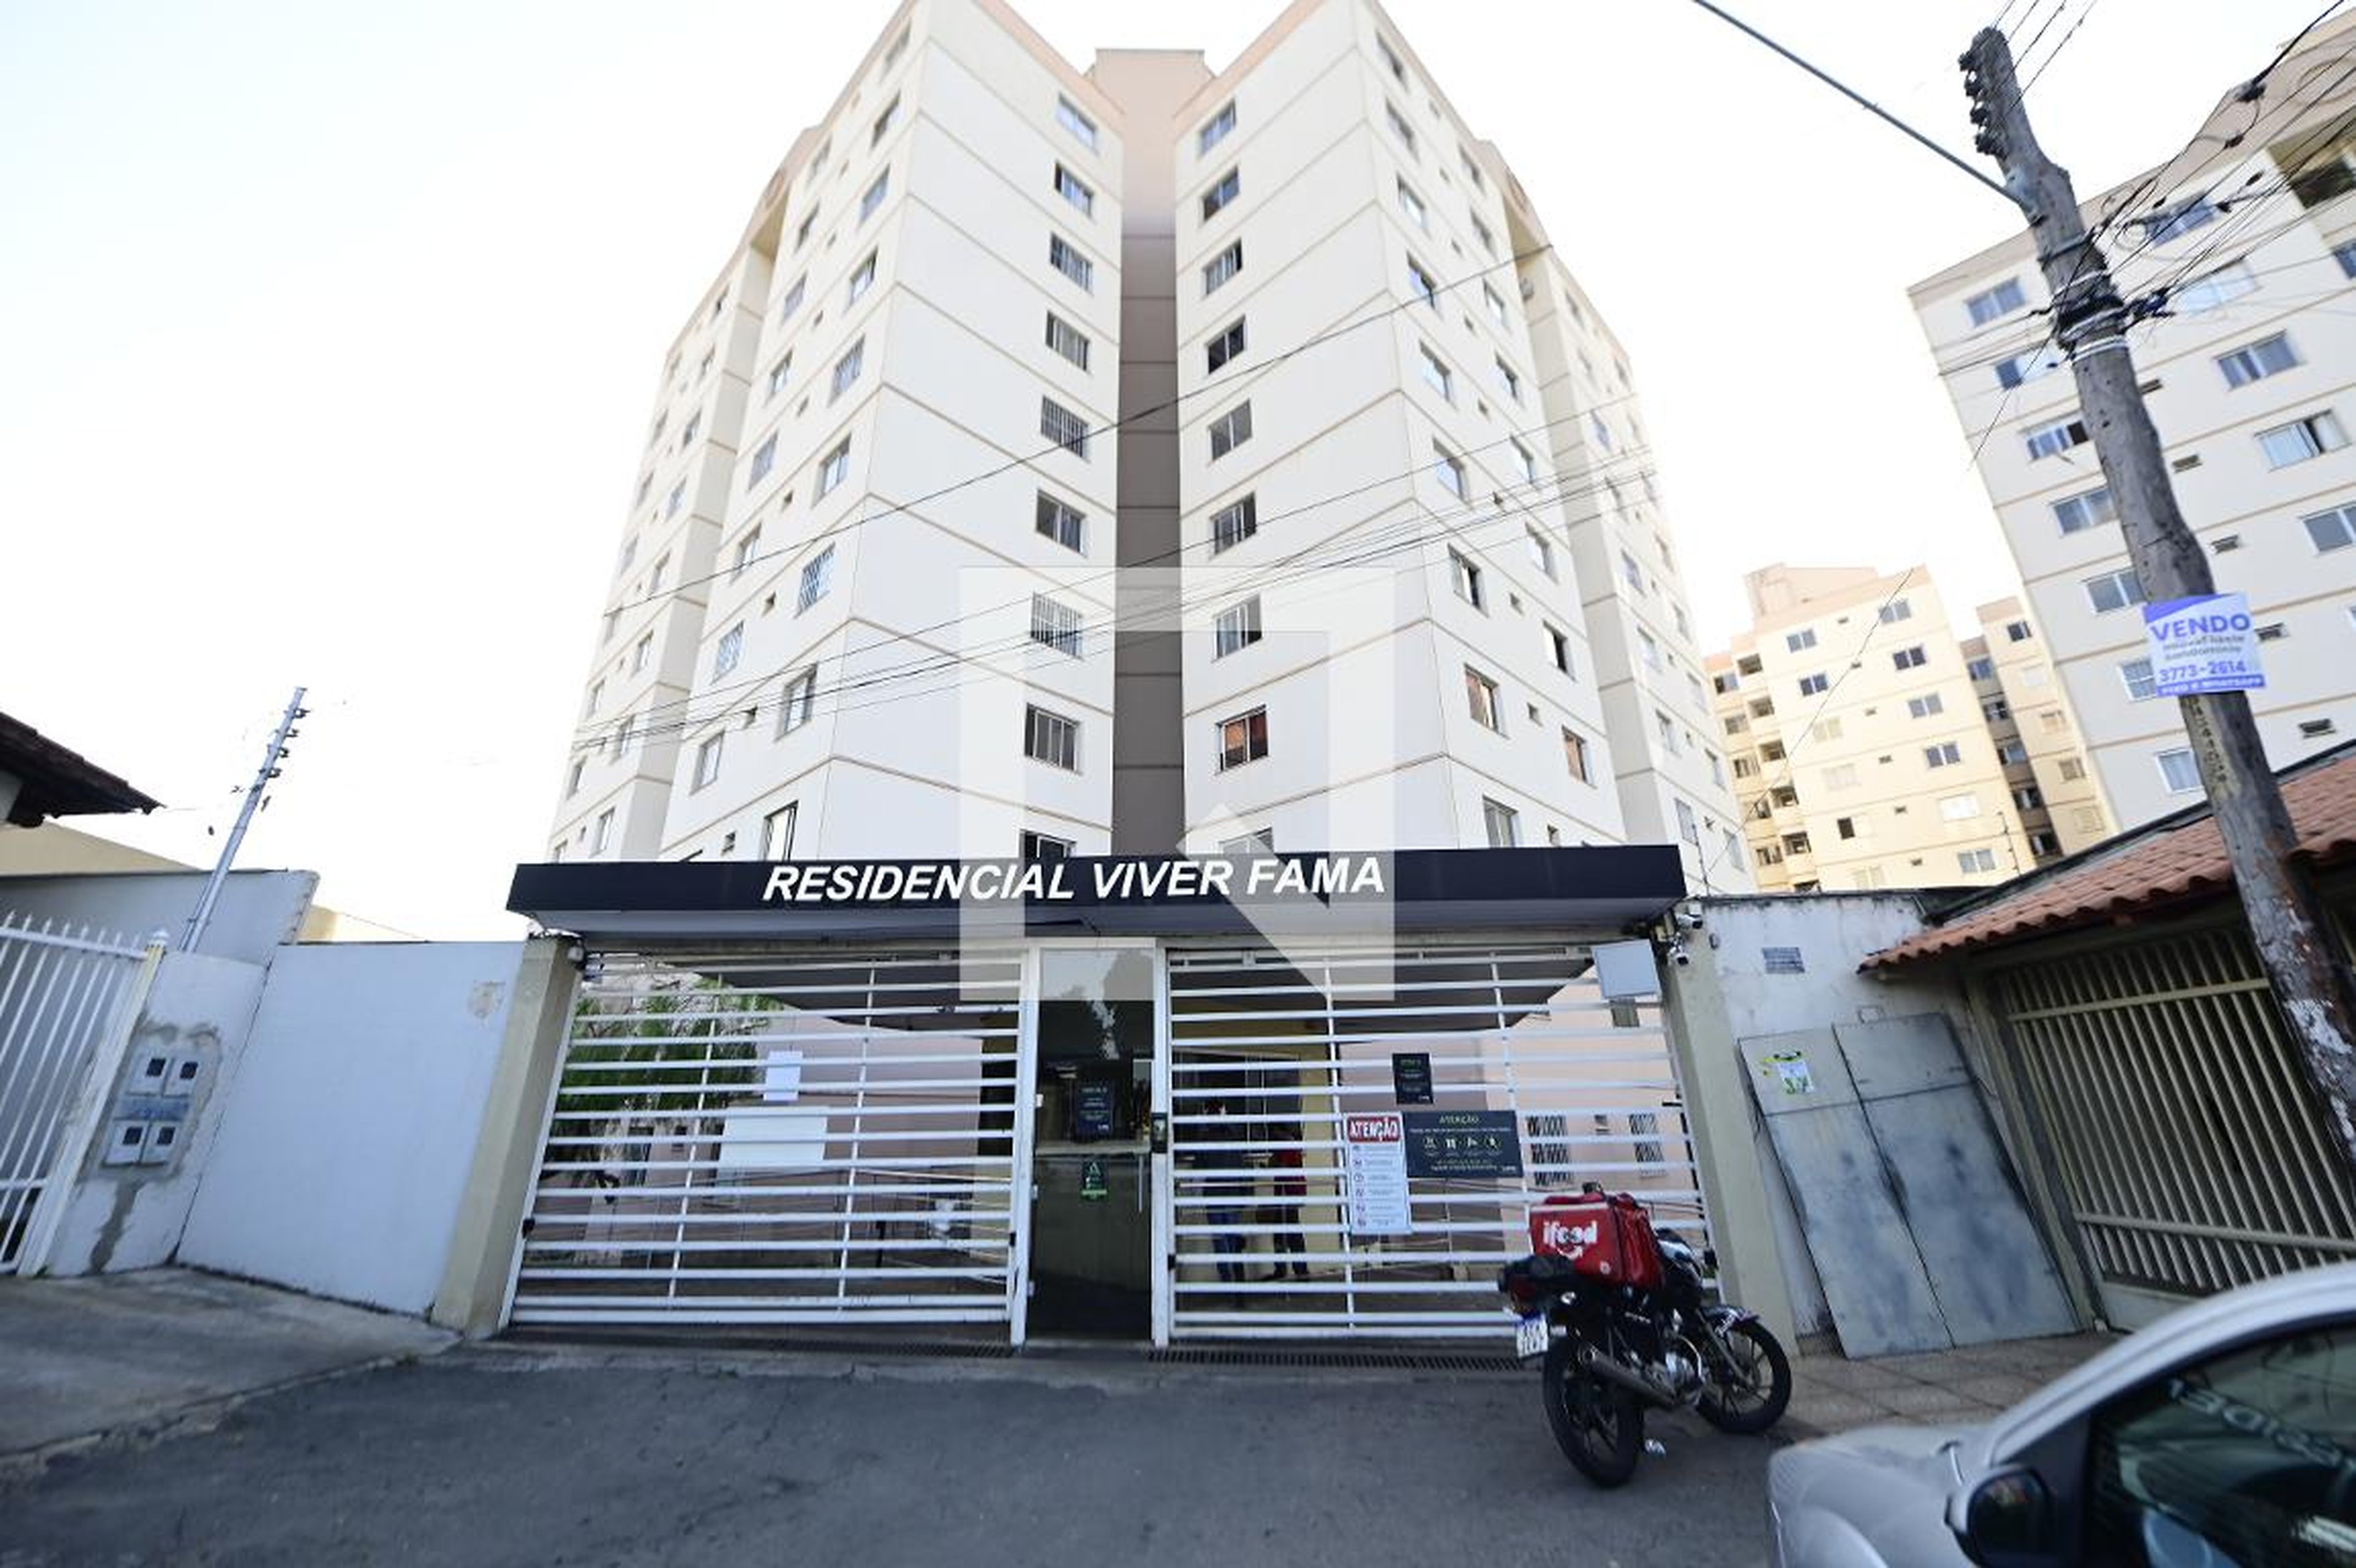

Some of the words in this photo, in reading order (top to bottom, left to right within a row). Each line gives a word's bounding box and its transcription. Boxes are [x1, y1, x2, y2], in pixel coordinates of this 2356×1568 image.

[2150, 613, 2250, 640] VENDO
[763, 864, 1074, 902] RESIDENCIAL
[1093, 861, 1231, 897] VIVER
[1247, 856, 1385, 894] FAMA
[1350, 1116, 1398, 1142] ATENÇÃO
[1439, 1113, 1479, 1124] ATENÇÃO
